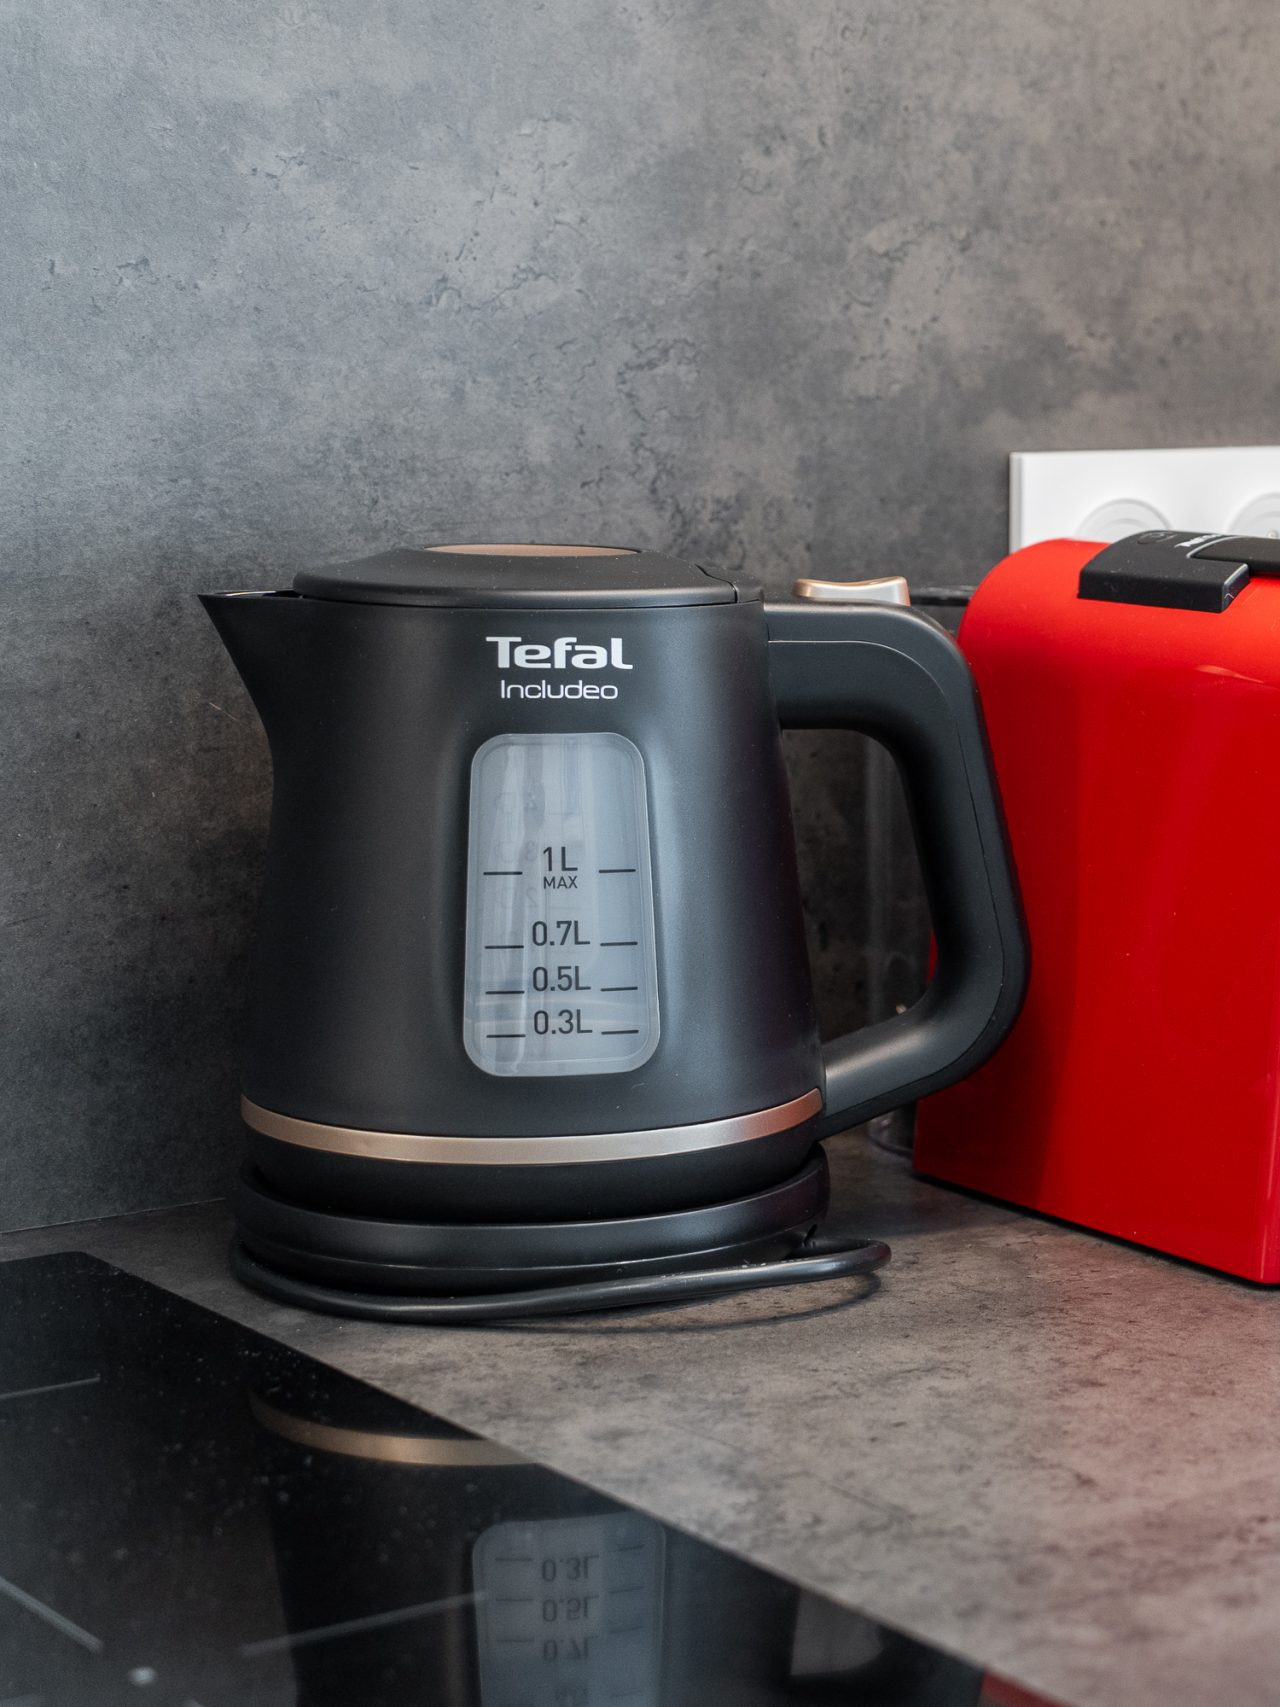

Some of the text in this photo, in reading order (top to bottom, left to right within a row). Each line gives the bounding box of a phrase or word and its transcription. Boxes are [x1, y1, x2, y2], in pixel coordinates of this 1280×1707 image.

[485, 636, 633, 670] Tefal
[500, 680, 618, 700] Includeo
[543, 876, 578, 889] MAX
[532, 920, 591, 947] 0.7L
[532, 966, 591, 992] 0.5L
[533, 1010, 593, 1036] 0.3L
